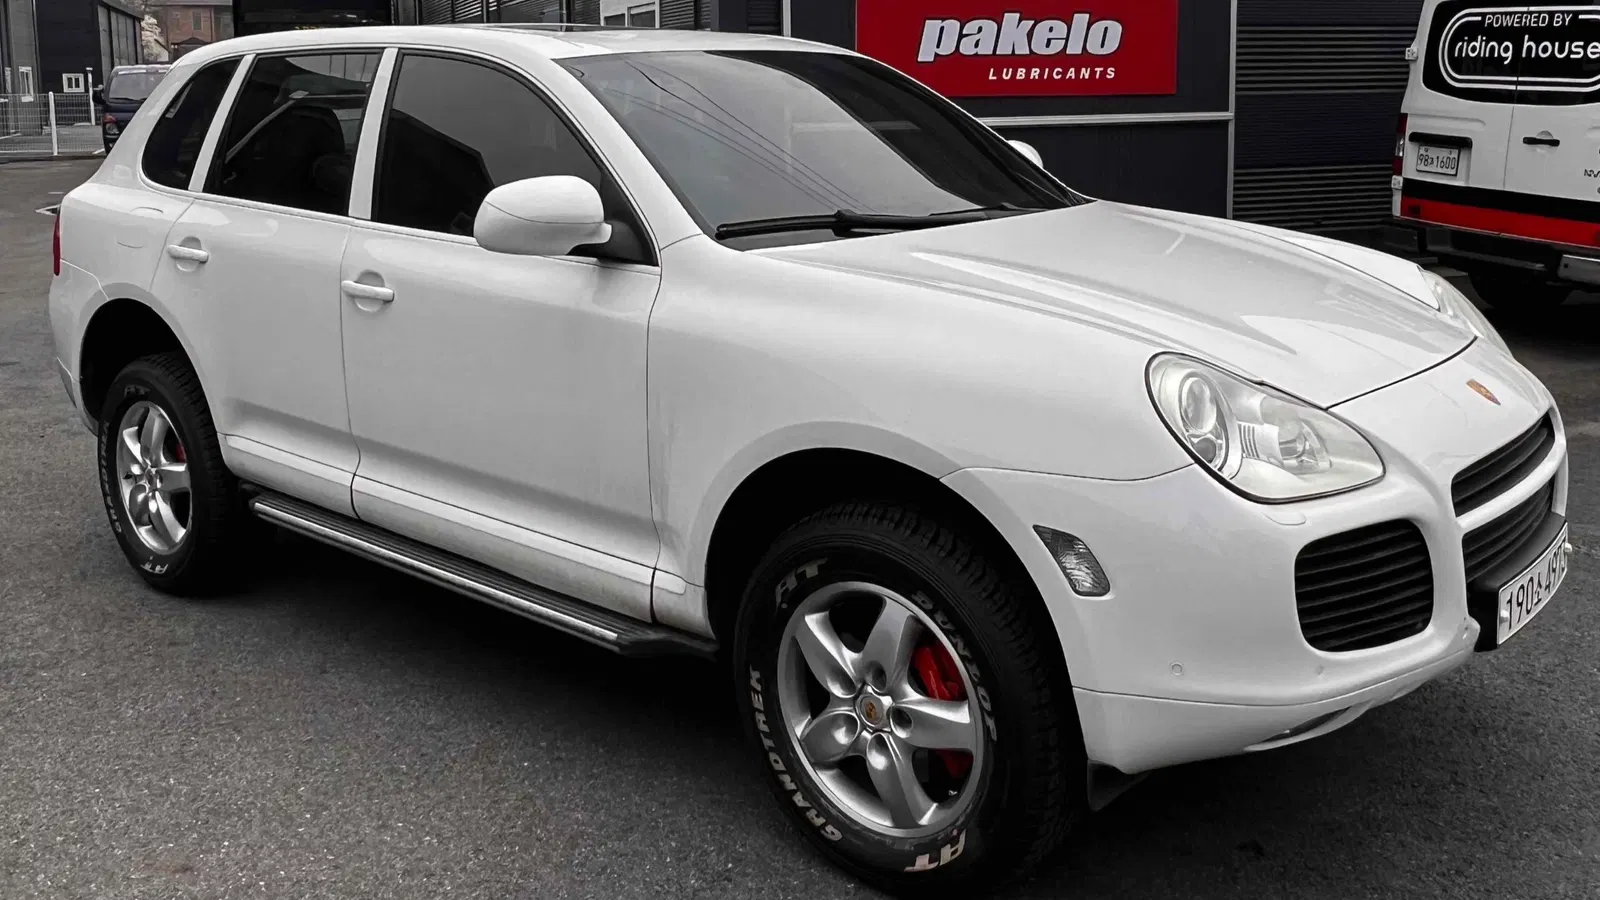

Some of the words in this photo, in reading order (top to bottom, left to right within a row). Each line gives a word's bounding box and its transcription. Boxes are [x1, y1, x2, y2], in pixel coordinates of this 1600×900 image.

[1485, 13, 1549, 27] POWERED
[1553, 13, 1573, 27] BY
[917, 13, 1123, 62] pakelo
[1455, 34, 1513, 64] riding
[1522, 34, 1600, 58] house
[989, 67, 1116, 80] LUBRICANTS
[750, 664, 843, 842] GRANDTREK
